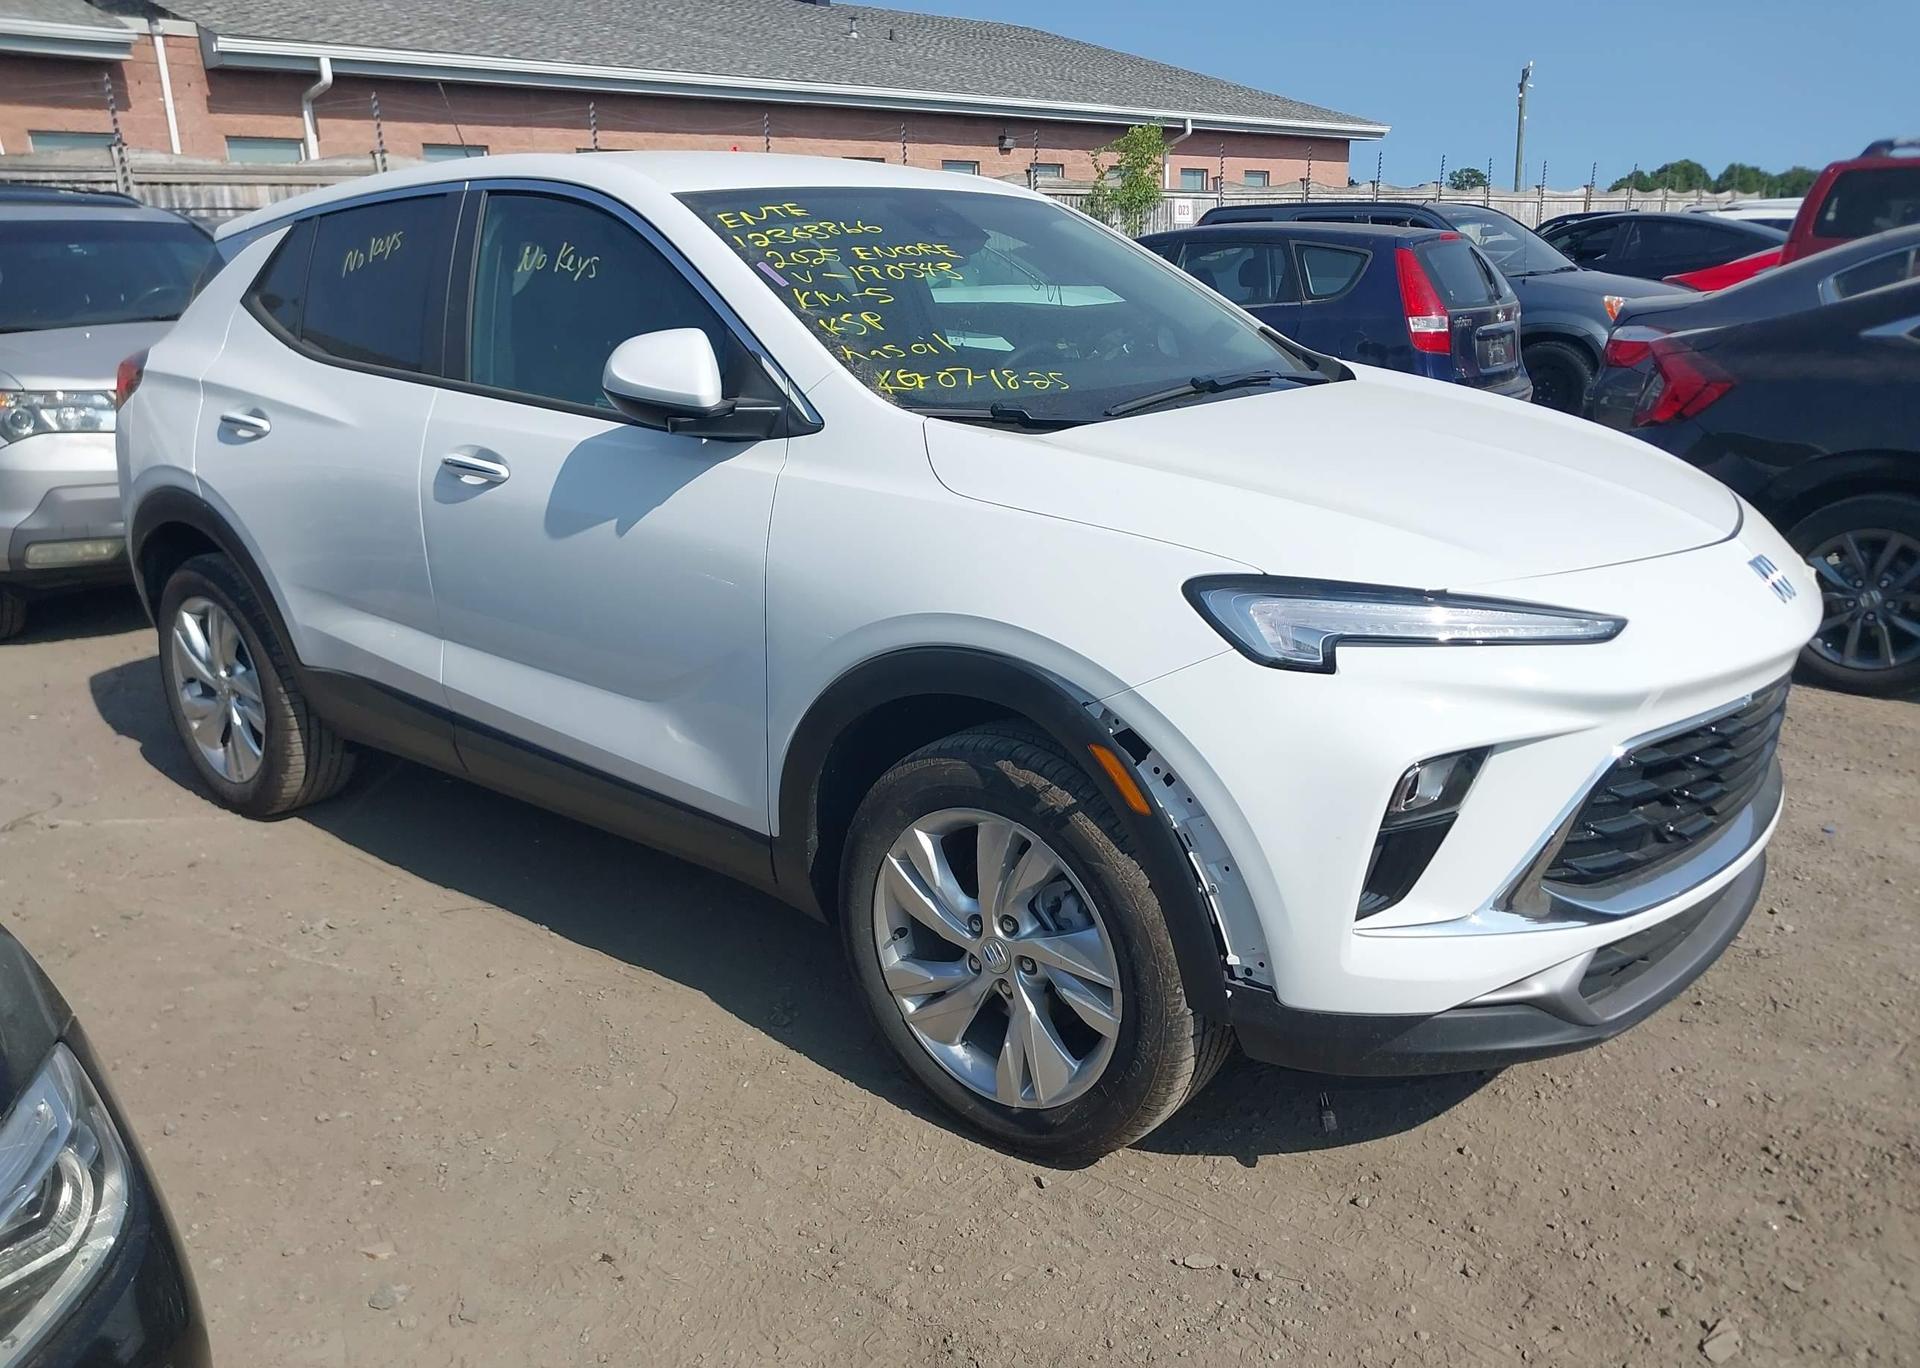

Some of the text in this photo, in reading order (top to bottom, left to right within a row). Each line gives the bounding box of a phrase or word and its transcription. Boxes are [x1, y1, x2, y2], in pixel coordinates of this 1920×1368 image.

[717, 203, 811, 228] ENTE
[342, 250, 364, 279] No
[517, 242, 600, 281] No Keys
[766, 242, 965, 269] 2025 ENCORE
[819, 311, 885, 336] KSP
